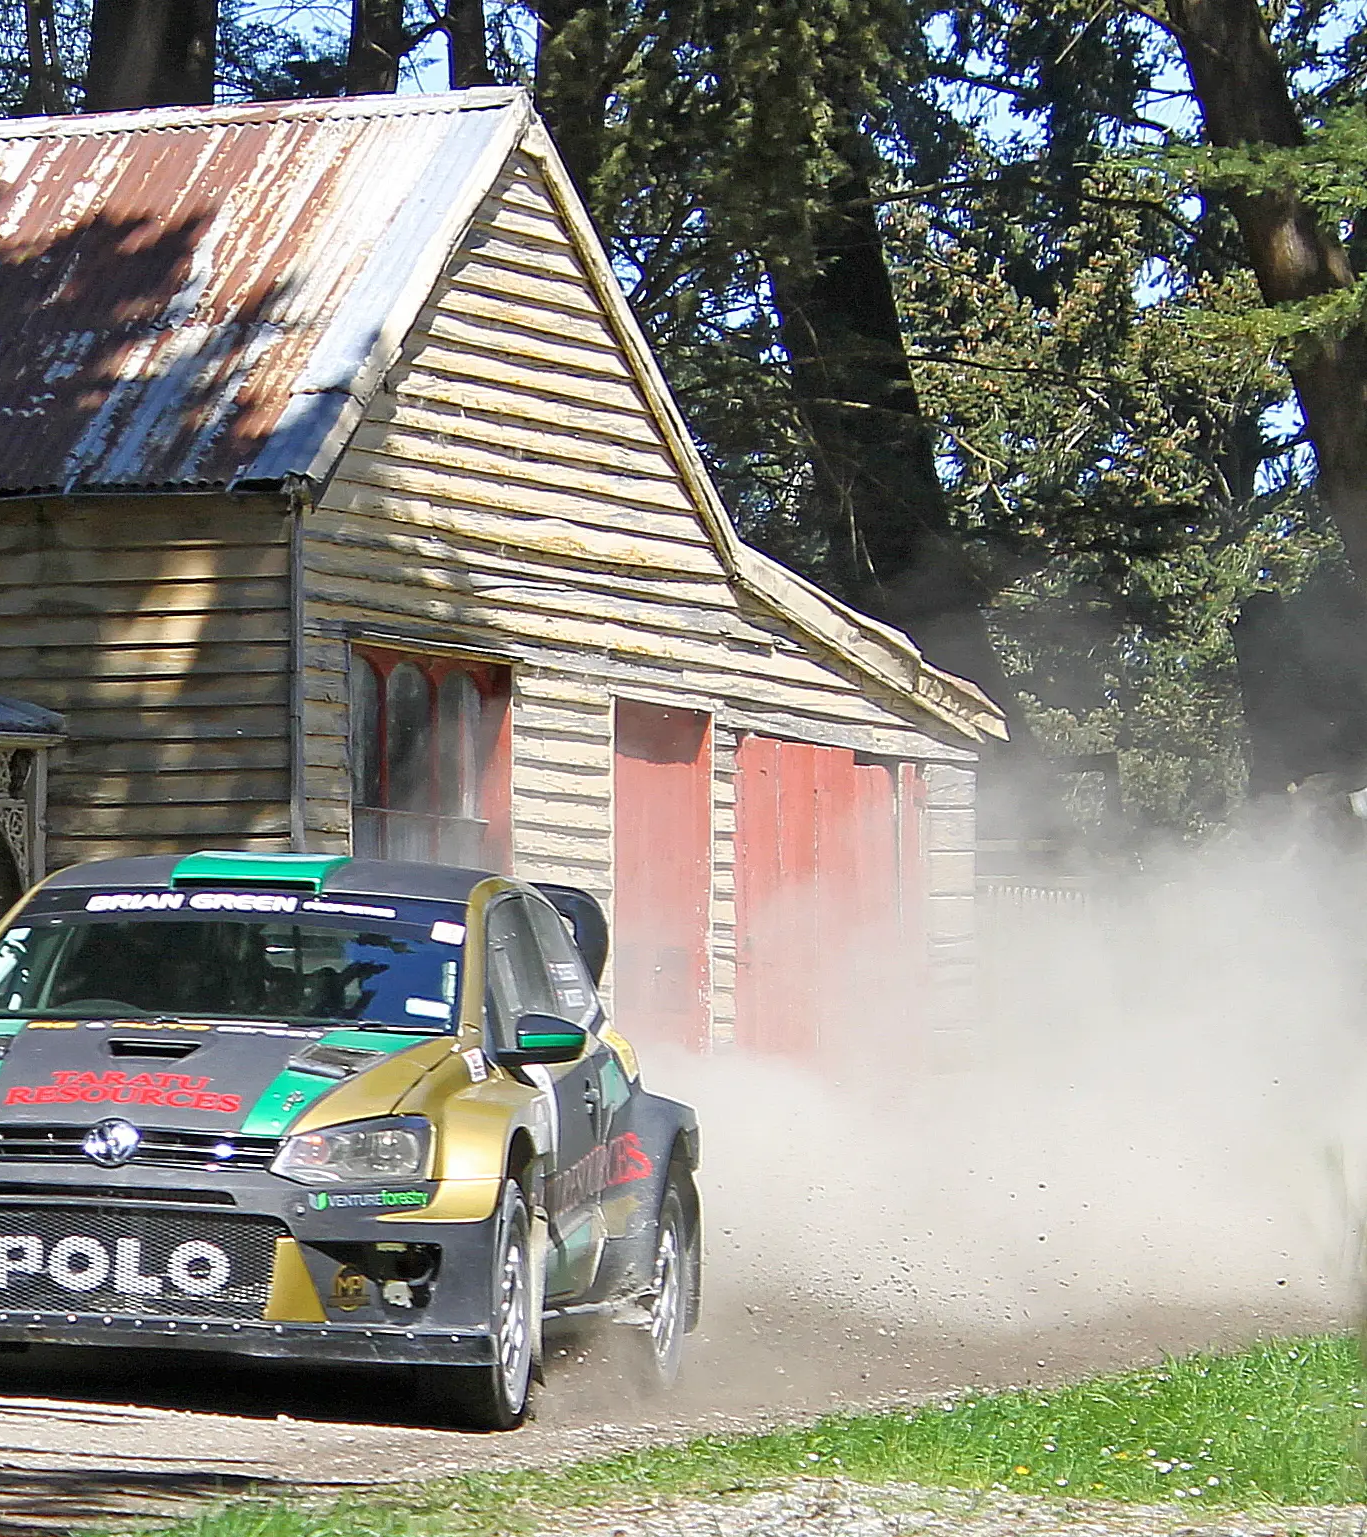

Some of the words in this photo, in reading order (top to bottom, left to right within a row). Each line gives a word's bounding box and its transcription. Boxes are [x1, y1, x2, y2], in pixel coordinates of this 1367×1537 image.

[85, 893, 184, 912] BRIAN
[189, 893, 298, 912] GREEN
[51, 1070, 210, 1091] TARATU
[4, 1086, 242, 1114] RESOURCES
